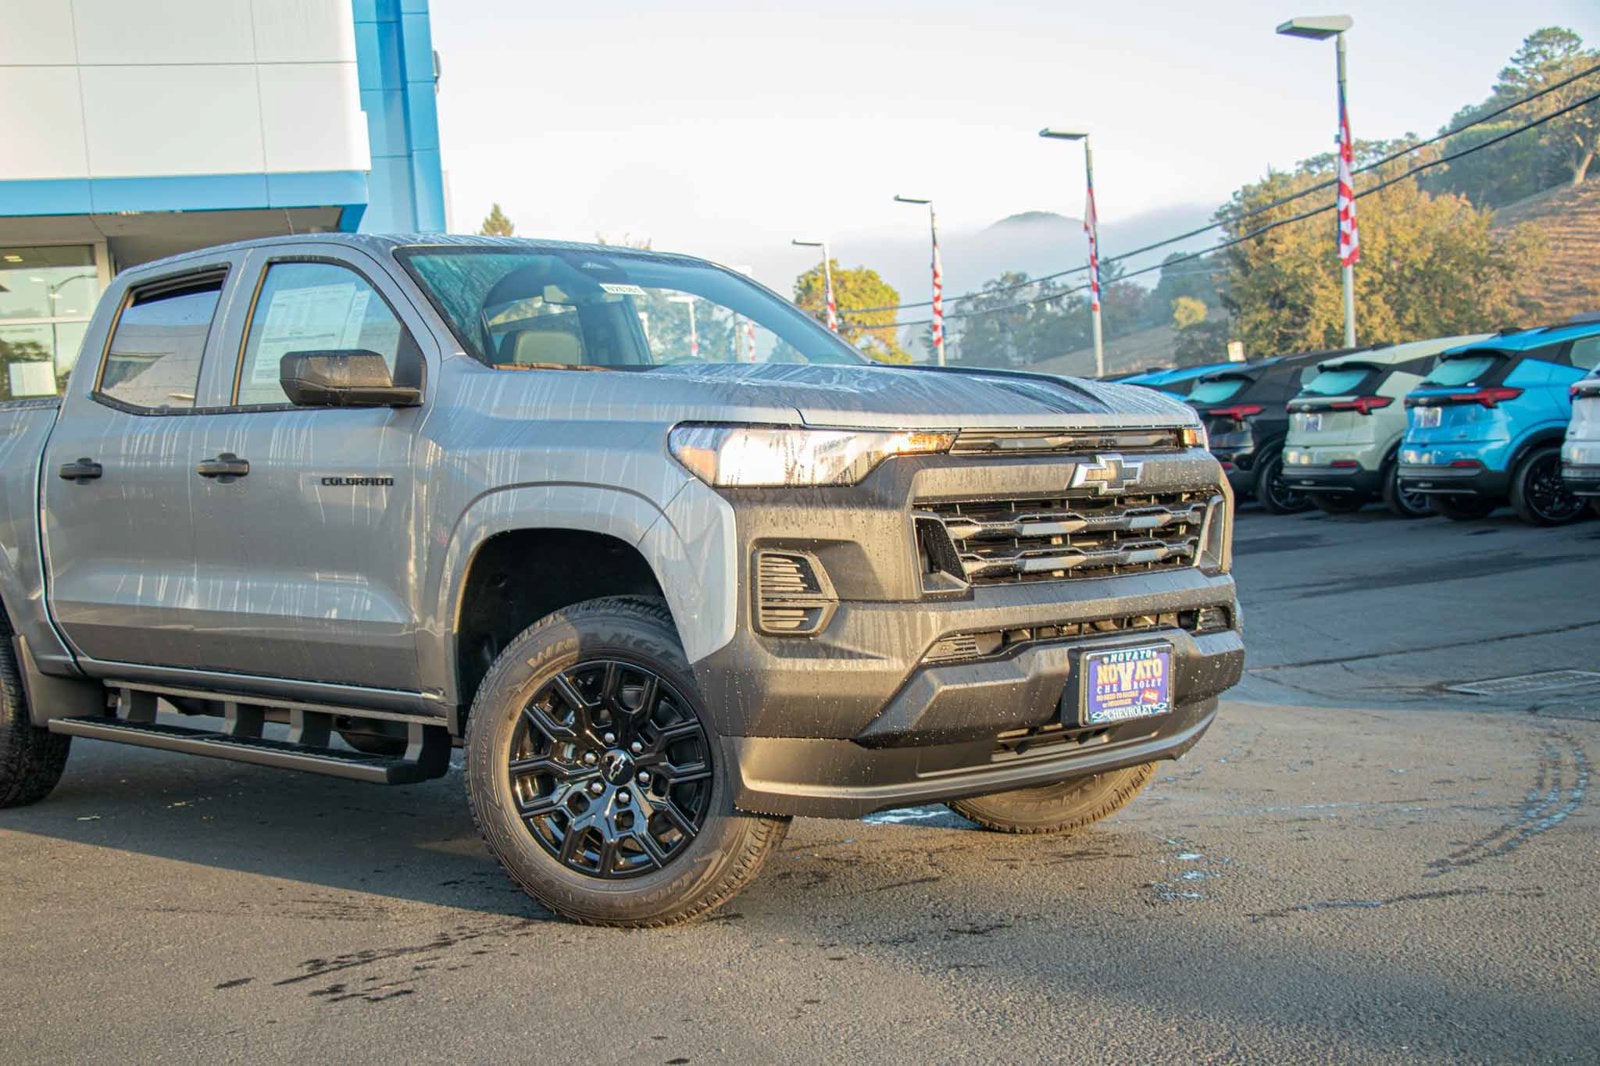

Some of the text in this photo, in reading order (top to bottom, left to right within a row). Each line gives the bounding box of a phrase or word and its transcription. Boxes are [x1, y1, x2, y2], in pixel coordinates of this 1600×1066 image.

[321, 477, 394, 486] COLORADO
[1110, 650, 1152, 663] NOVATO
[1097, 659, 1162, 690] NOVATO
[1108, 705, 1152, 719] CHEVROLET
